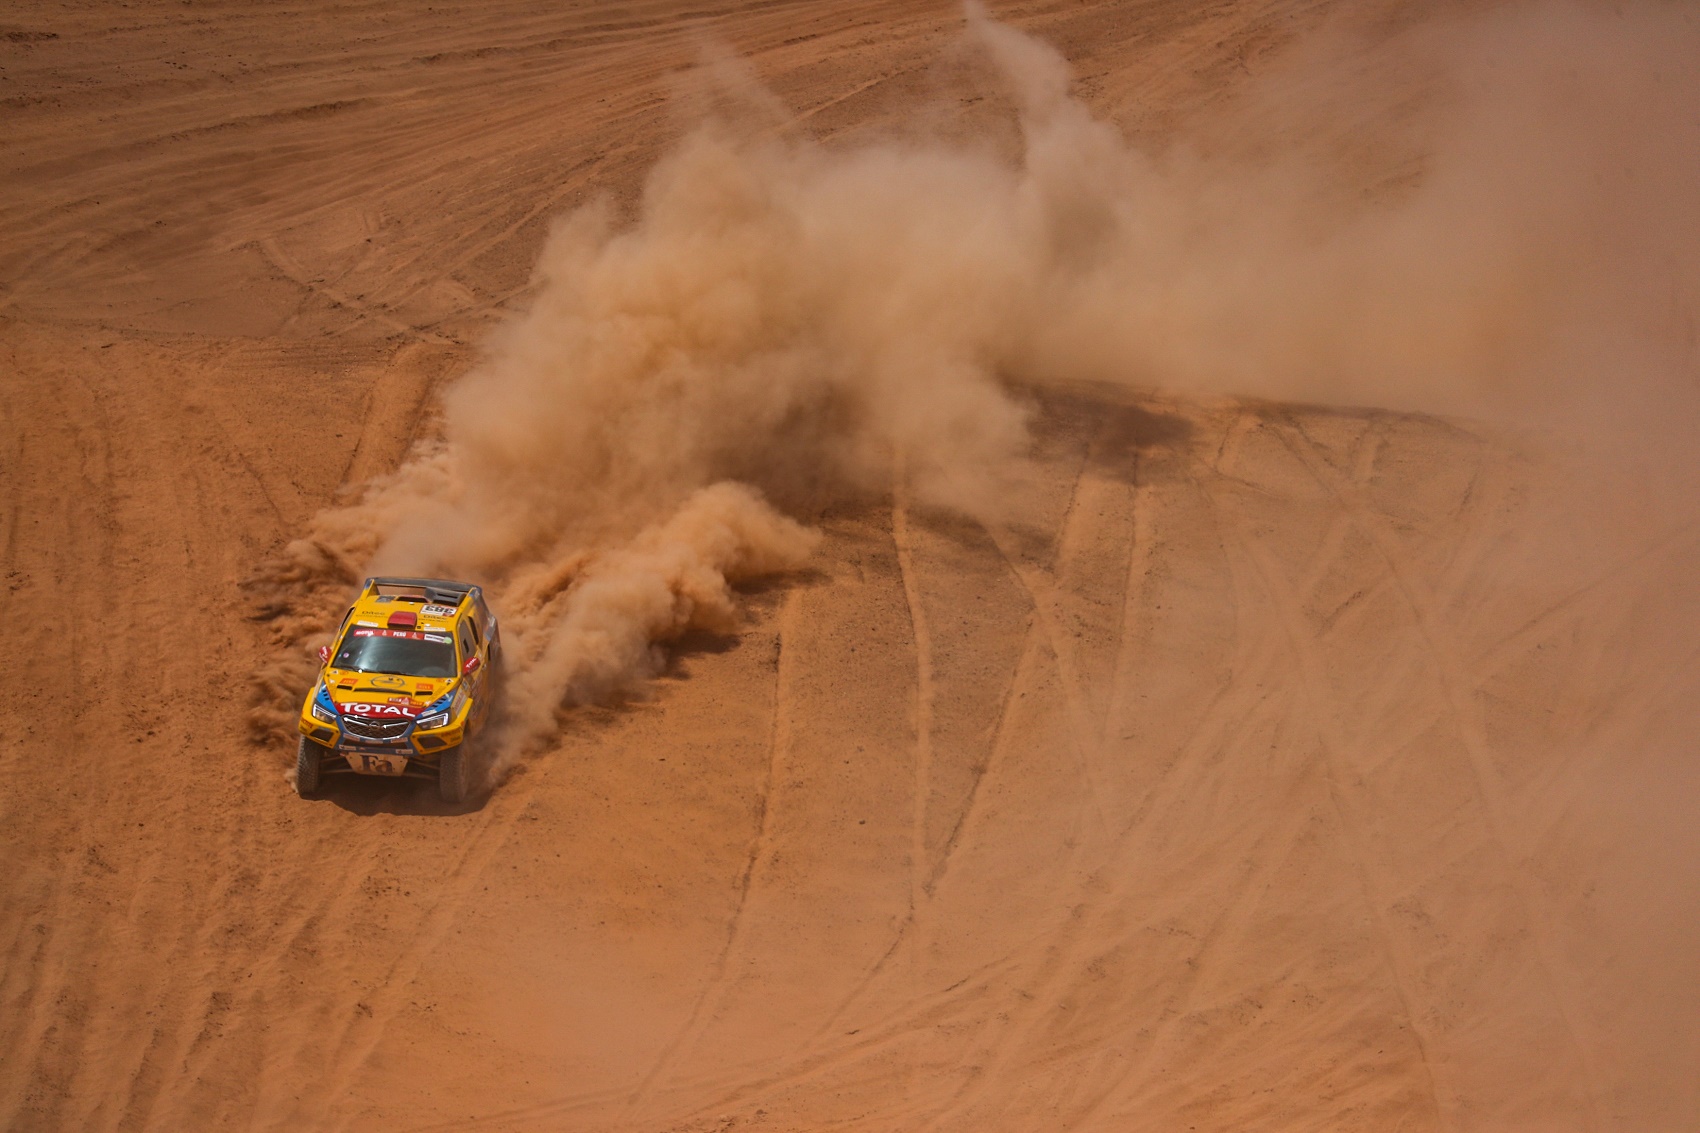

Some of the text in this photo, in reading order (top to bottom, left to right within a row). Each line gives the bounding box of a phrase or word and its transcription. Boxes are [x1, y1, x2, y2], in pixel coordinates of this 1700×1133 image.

[425, 605, 454, 613] 383
[340, 702, 416, 718] TOTAL
[360, 755, 393, 773] Fa
